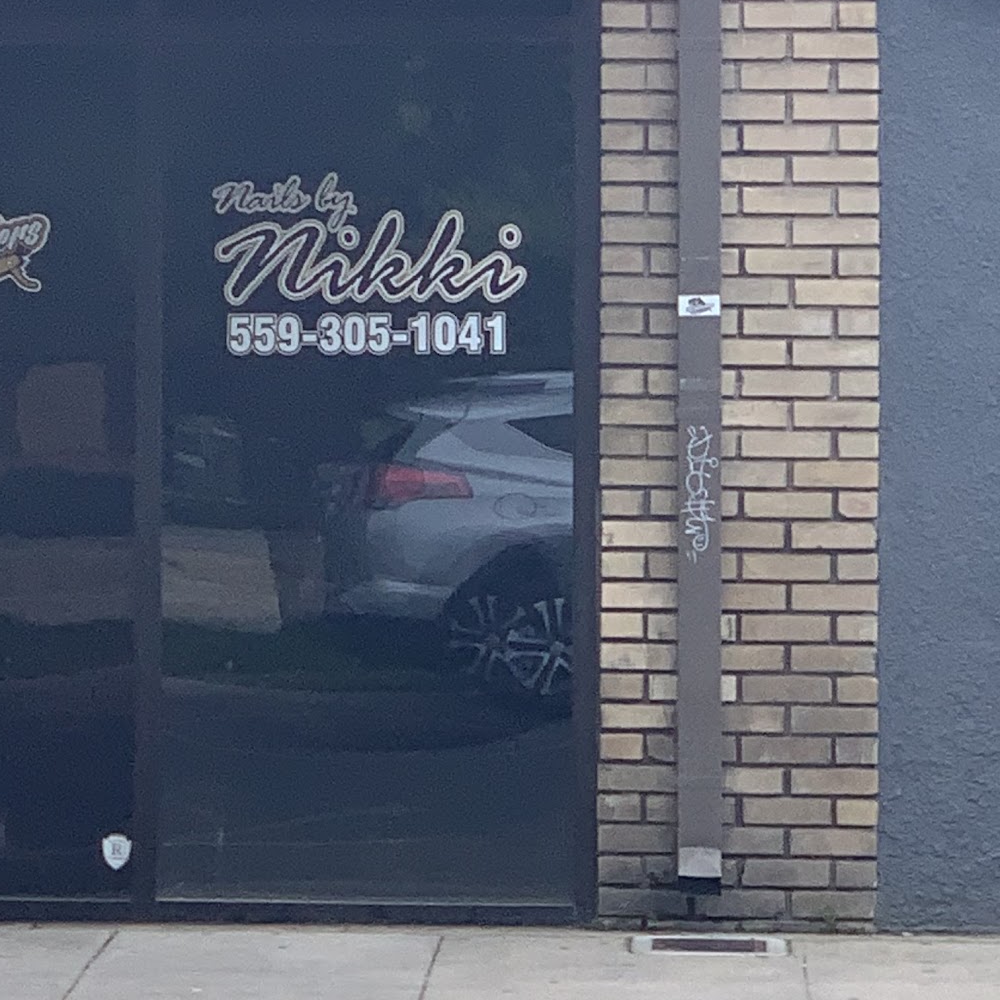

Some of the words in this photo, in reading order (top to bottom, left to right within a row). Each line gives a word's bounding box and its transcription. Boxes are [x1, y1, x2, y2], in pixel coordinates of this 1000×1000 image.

[212, 175, 312, 214] Nails
[315, 172, 358, 234] by
[214, 209, 528, 306] Nikki
[227, 312, 506, 356] 559-305-1041
